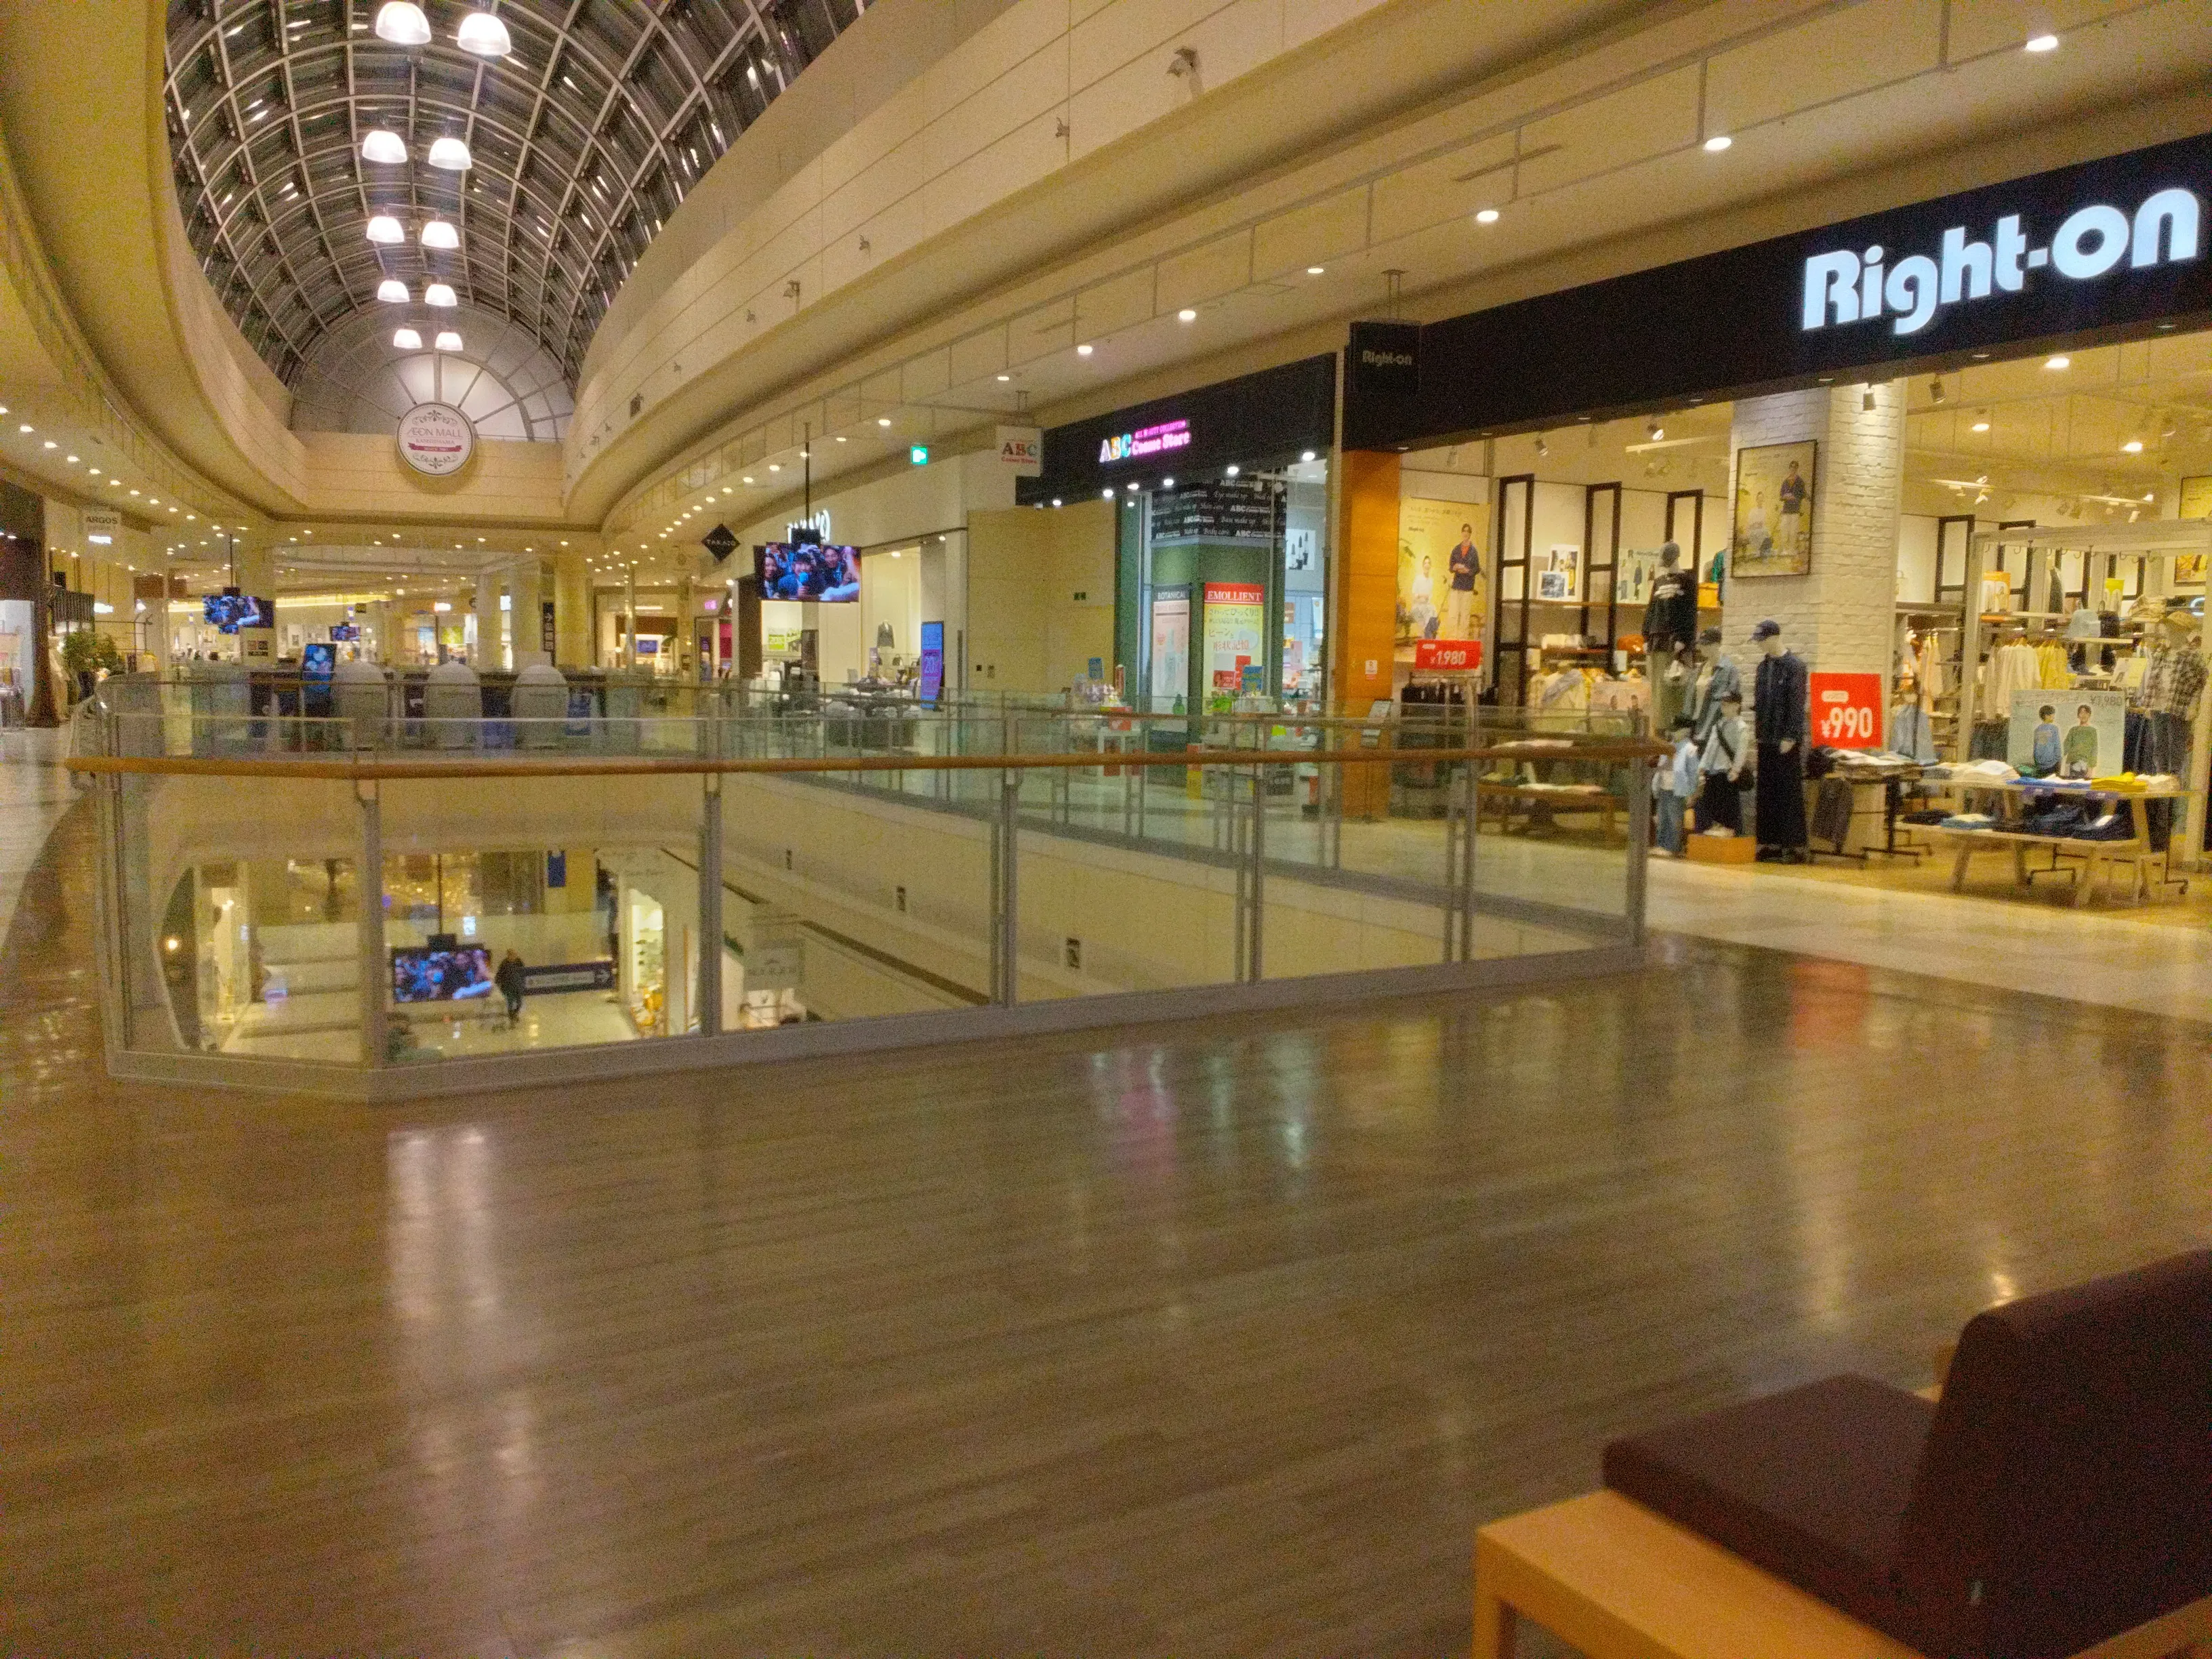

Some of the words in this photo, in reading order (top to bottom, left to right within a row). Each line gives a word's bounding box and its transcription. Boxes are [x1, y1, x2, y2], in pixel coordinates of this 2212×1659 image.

[1802, 188, 2200, 335] Right-on
[1362, 350, 1412, 367] Right-on
[1002, 442, 1038, 457] ABC
[1099, 434, 1132, 463] ABC
[1208, 590, 1262, 602] EMOLLIENT
[1820, 707, 1872, 739] ¥990
